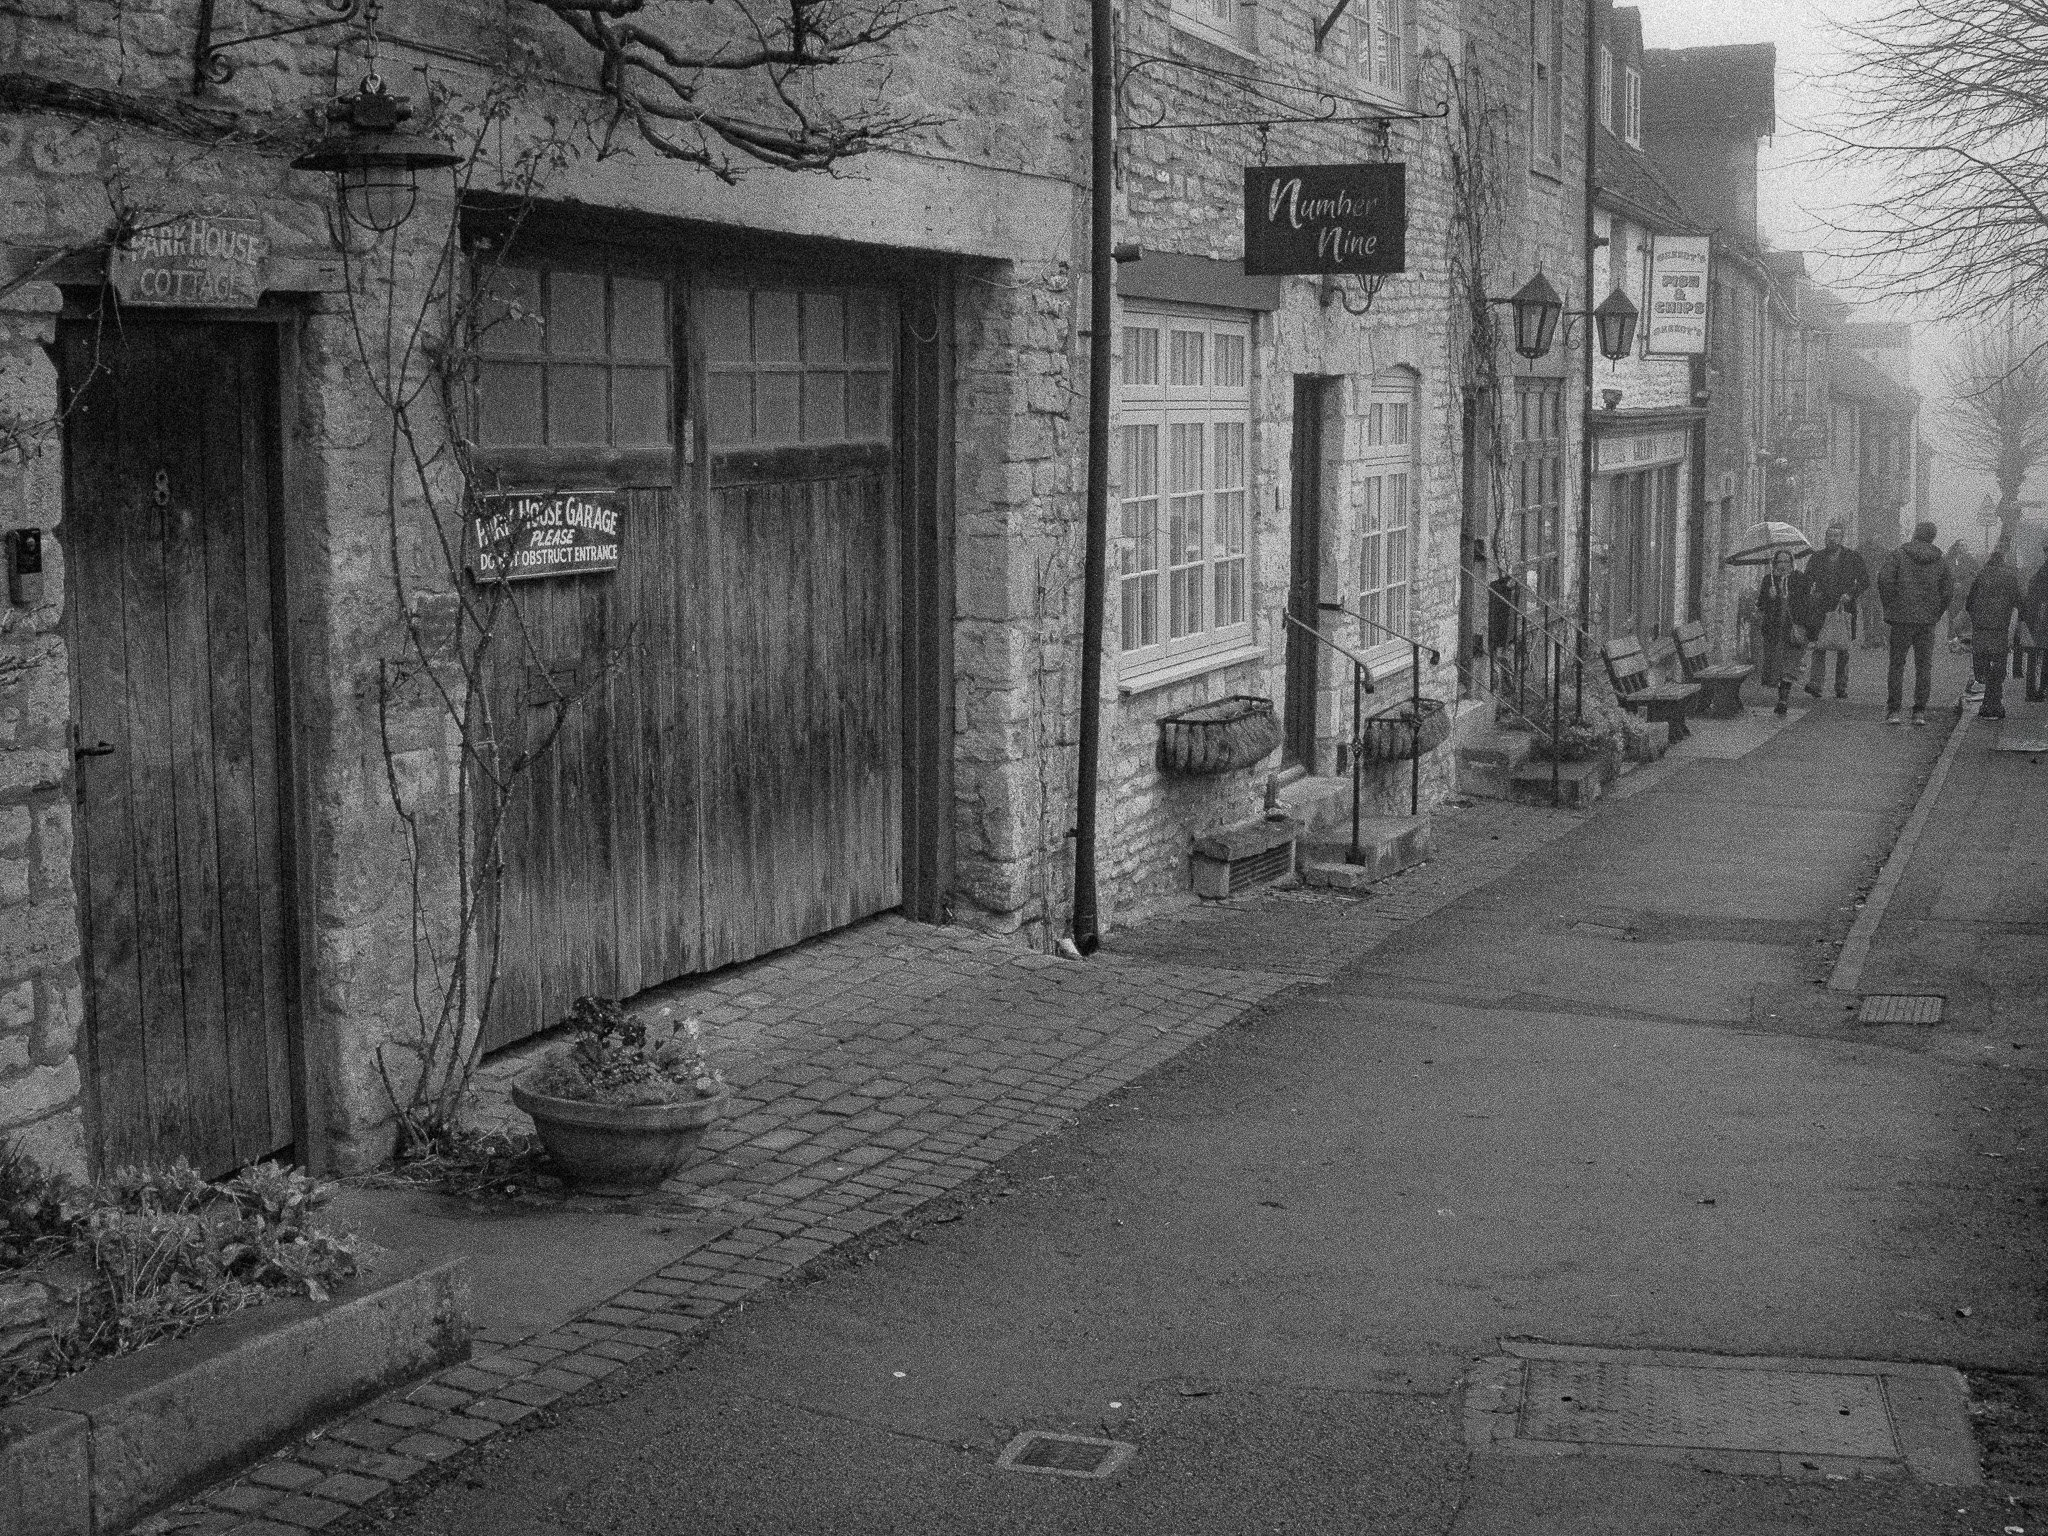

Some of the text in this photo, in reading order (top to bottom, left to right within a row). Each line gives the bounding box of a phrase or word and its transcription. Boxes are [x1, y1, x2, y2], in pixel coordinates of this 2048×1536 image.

[1268, 178, 1378, 229] Number
[131, 220, 259, 266] PARK HOUSE
[1318, 227, 1377, 263] Nine
[1661, 275, 1700, 288] FISH
[1674, 288, 1686, 301] &
[1655, 301, 1705, 314] CHIPS
[565, 496, 618, 535] GARAGE
[530, 529, 576, 547] PLEASE
[521, 547, 573, 566] OBSTRUCT
[574, 545, 618, 562] ENTRANCE
